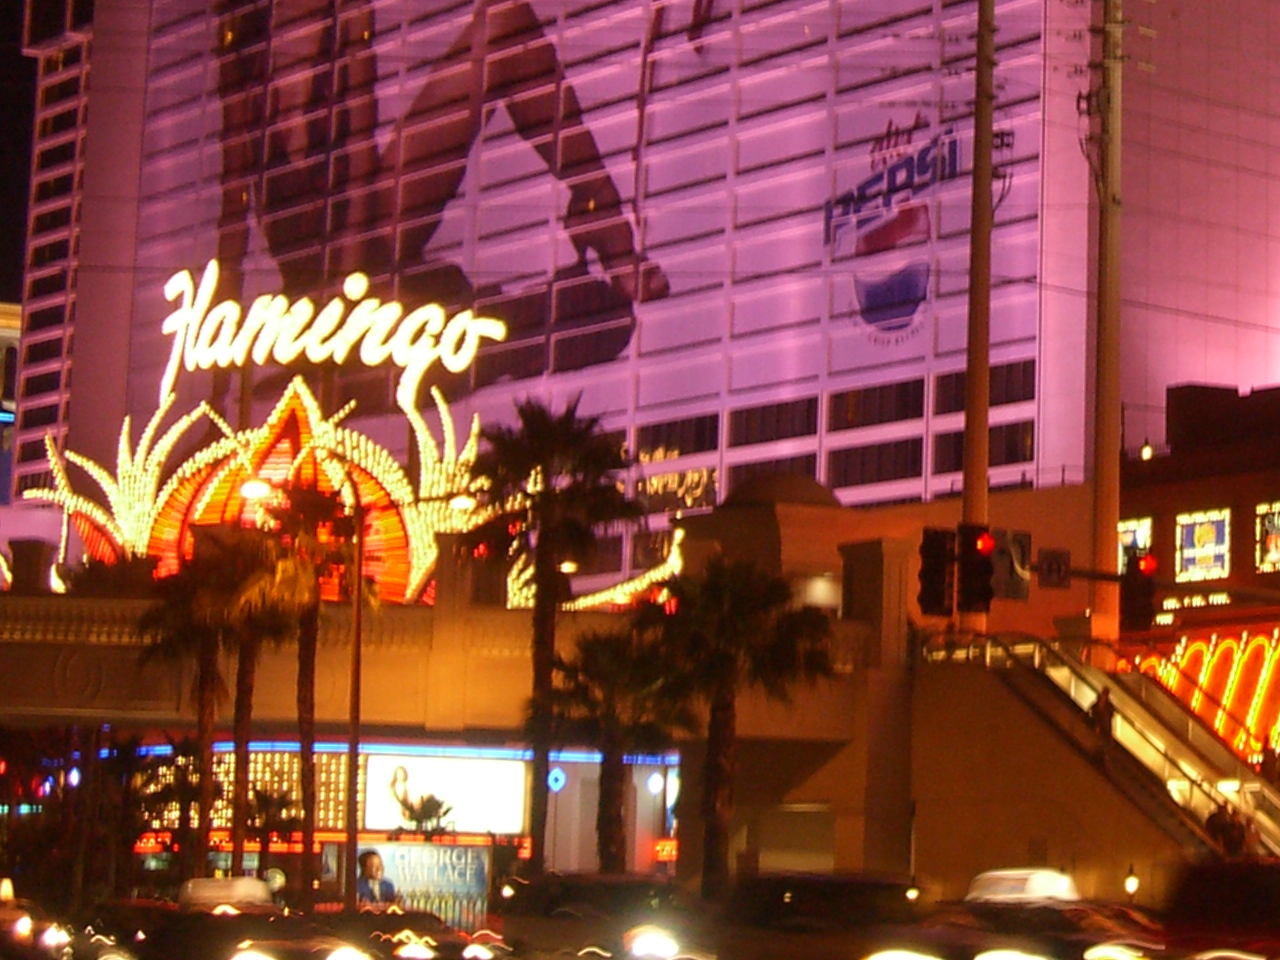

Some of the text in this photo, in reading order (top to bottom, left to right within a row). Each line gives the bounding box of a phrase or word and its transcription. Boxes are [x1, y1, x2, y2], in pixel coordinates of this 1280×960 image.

[823, 125, 959, 246] PEPSI
[161, 258, 507, 412] Flamingo
[394, 846, 478, 868] GEORGE
[398, 865, 477, 886] WALLACE
